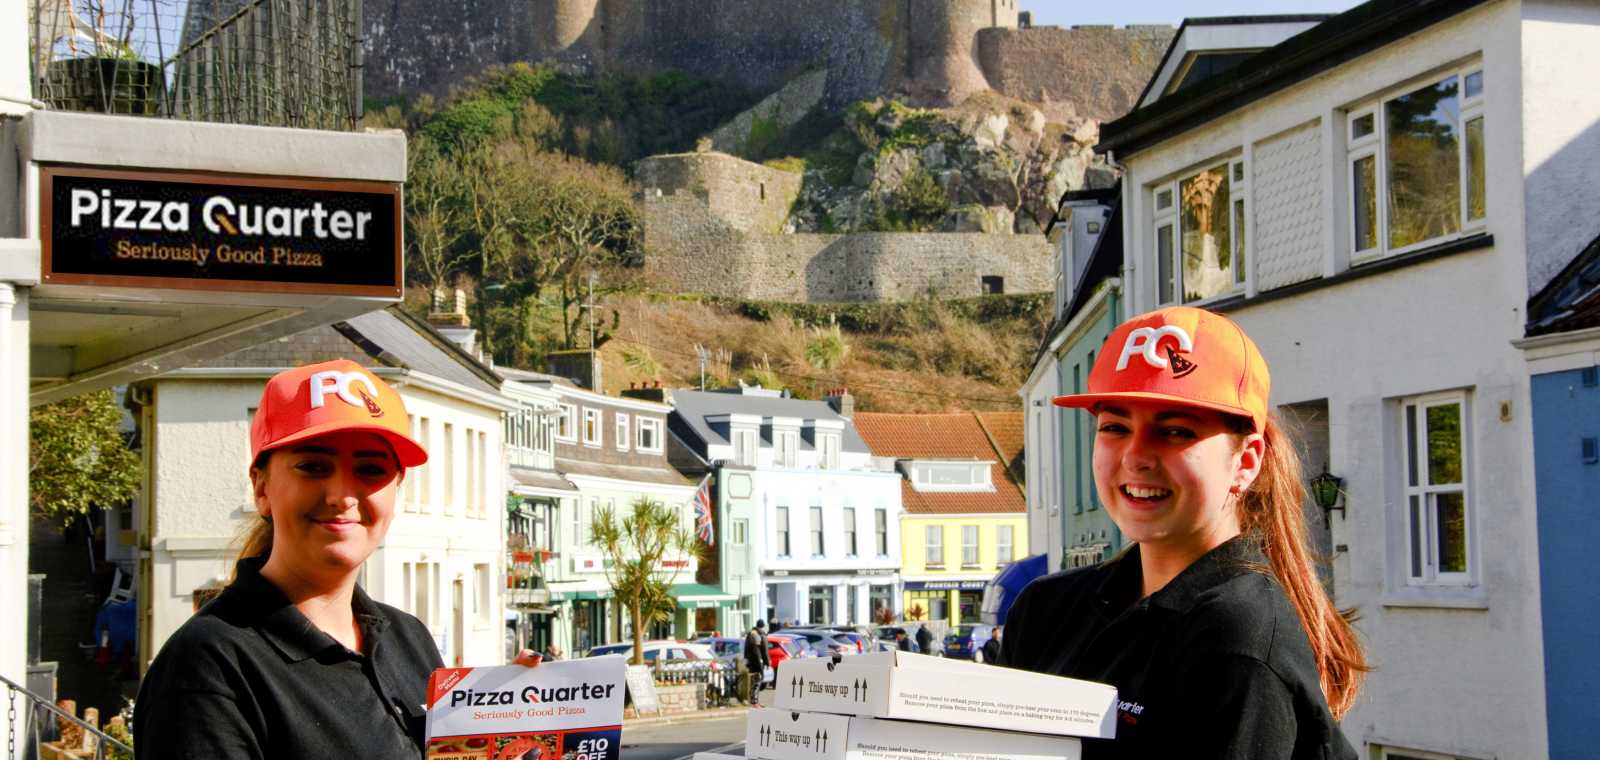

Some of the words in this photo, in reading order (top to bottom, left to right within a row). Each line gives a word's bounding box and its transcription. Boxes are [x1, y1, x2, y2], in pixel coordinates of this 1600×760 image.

[71, 188, 189, 232] Pizza
[203, 196, 372, 240] Quarter
[117, 240, 210, 266] Seriously
[216, 245, 264, 264] Good
[273, 247, 322, 267] Pizza
[451, 689, 514, 707] Pizza
[521, 682, 615, 704] Quarter
[808, 681, 822, 693] This
[824, 684, 838, 697] way
[839, 685, 849, 698] up
[474, 709, 524, 720] Seriously
[527, 706, 554, 717] Good
[558, 706, 585, 716] Pizza
[1117, 700, 1144, 715] uarter
[577, 738, 608, 753] £10
[775, 731, 788, 743] This
[789, 733, 801, 746] way
[801, 736, 811, 748] up
